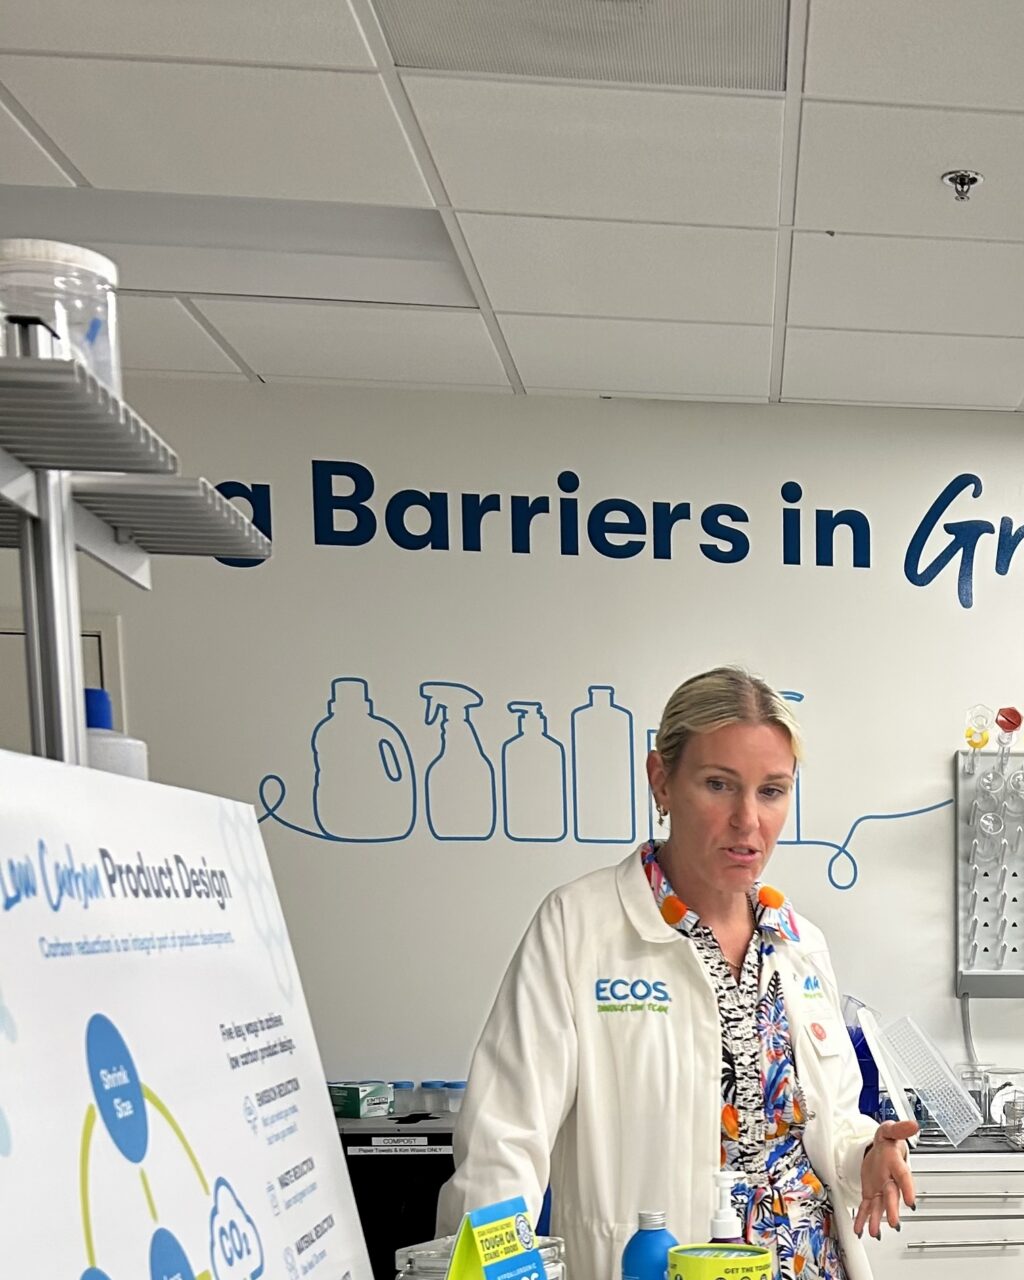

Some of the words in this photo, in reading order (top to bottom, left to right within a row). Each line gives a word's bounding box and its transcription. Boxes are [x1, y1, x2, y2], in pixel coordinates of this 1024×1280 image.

[311, 460, 750, 563] Barriers
[781, 481, 871, 568] in
[0, 857, 37, 912] Low
[38, 838, 105, 912] Carbon
[98, 848, 180, 898] Product
[173, 854, 233, 910] Design
[595, 979, 670, 1001] ECOS
[100, 1066, 130, 1090] Shrink
[113, 1098, 133, 1119] Size
[480, 1234, 504, 1252] TOUGH
[506, 1231, 516, 1244] ON
[741, 1266, 753, 1274] THE
